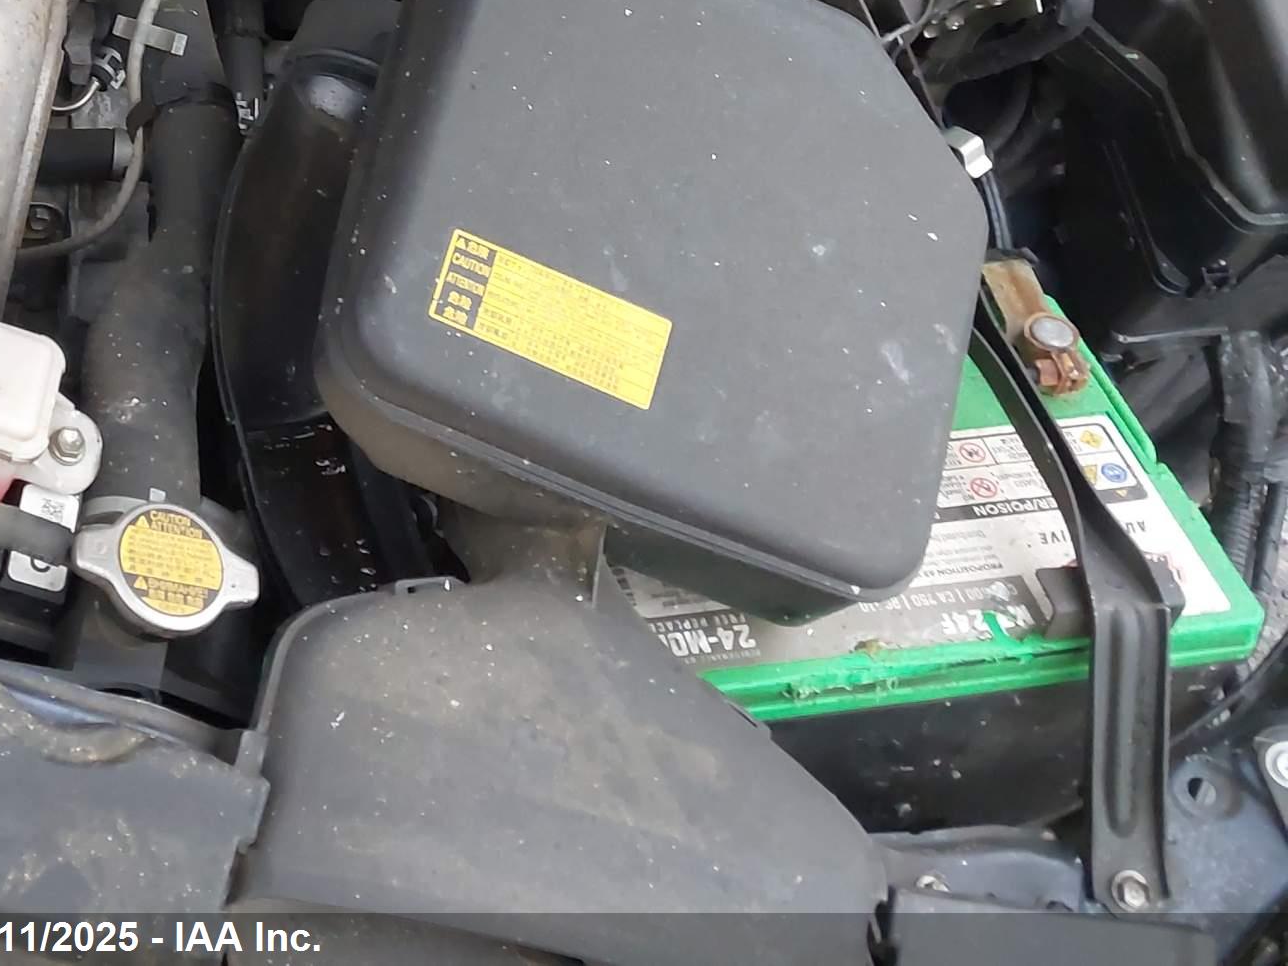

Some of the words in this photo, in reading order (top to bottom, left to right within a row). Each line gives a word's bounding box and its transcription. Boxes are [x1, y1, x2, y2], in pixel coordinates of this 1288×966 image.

[452, 252, 493, 277] CAUTION
[149, 510, 191, 527] CAUTION
[150, 520, 203, 540] ATTENTION
